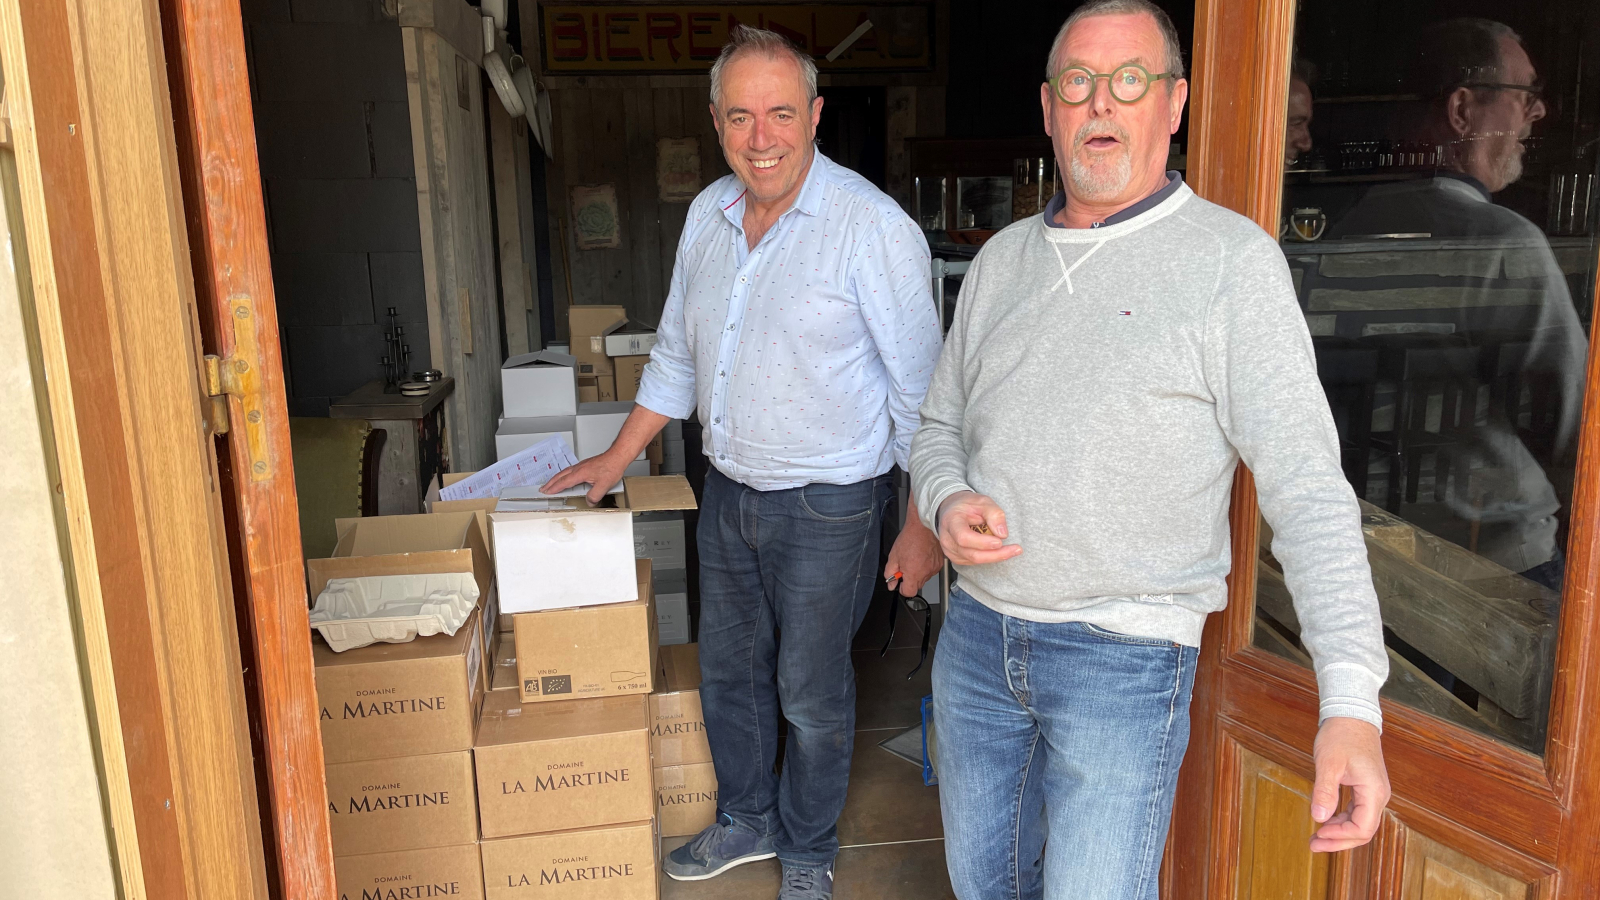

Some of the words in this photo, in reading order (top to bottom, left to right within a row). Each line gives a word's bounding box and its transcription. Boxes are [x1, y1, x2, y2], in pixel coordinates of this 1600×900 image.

[356, 687, 396, 697] DOMAINE
[320, 706, 334, 720] A
[342, 696, 446, 720] MARTINE
[655, 713, 684, 721] DOMAINE
[651, 721, 707, 737] MARTIN
[547, 761, 584, 770] DOMAINE
[361, 783, 401, 792] DOMAINE
[501, 779, 525, 795] LA
[533, 768, 630, 793] MARTINE
[328, 801, 340, 814] A
[348, 791, 450, 814] MARTINE
[552, 855, 589, 865] DOMAINE
[374, 874, 412, 883] DOMAINE
[507, 873, 531, 888] LA
[539, 863, 634, 886] MARTINE
[362, 882, 460, 900] MARTINE
